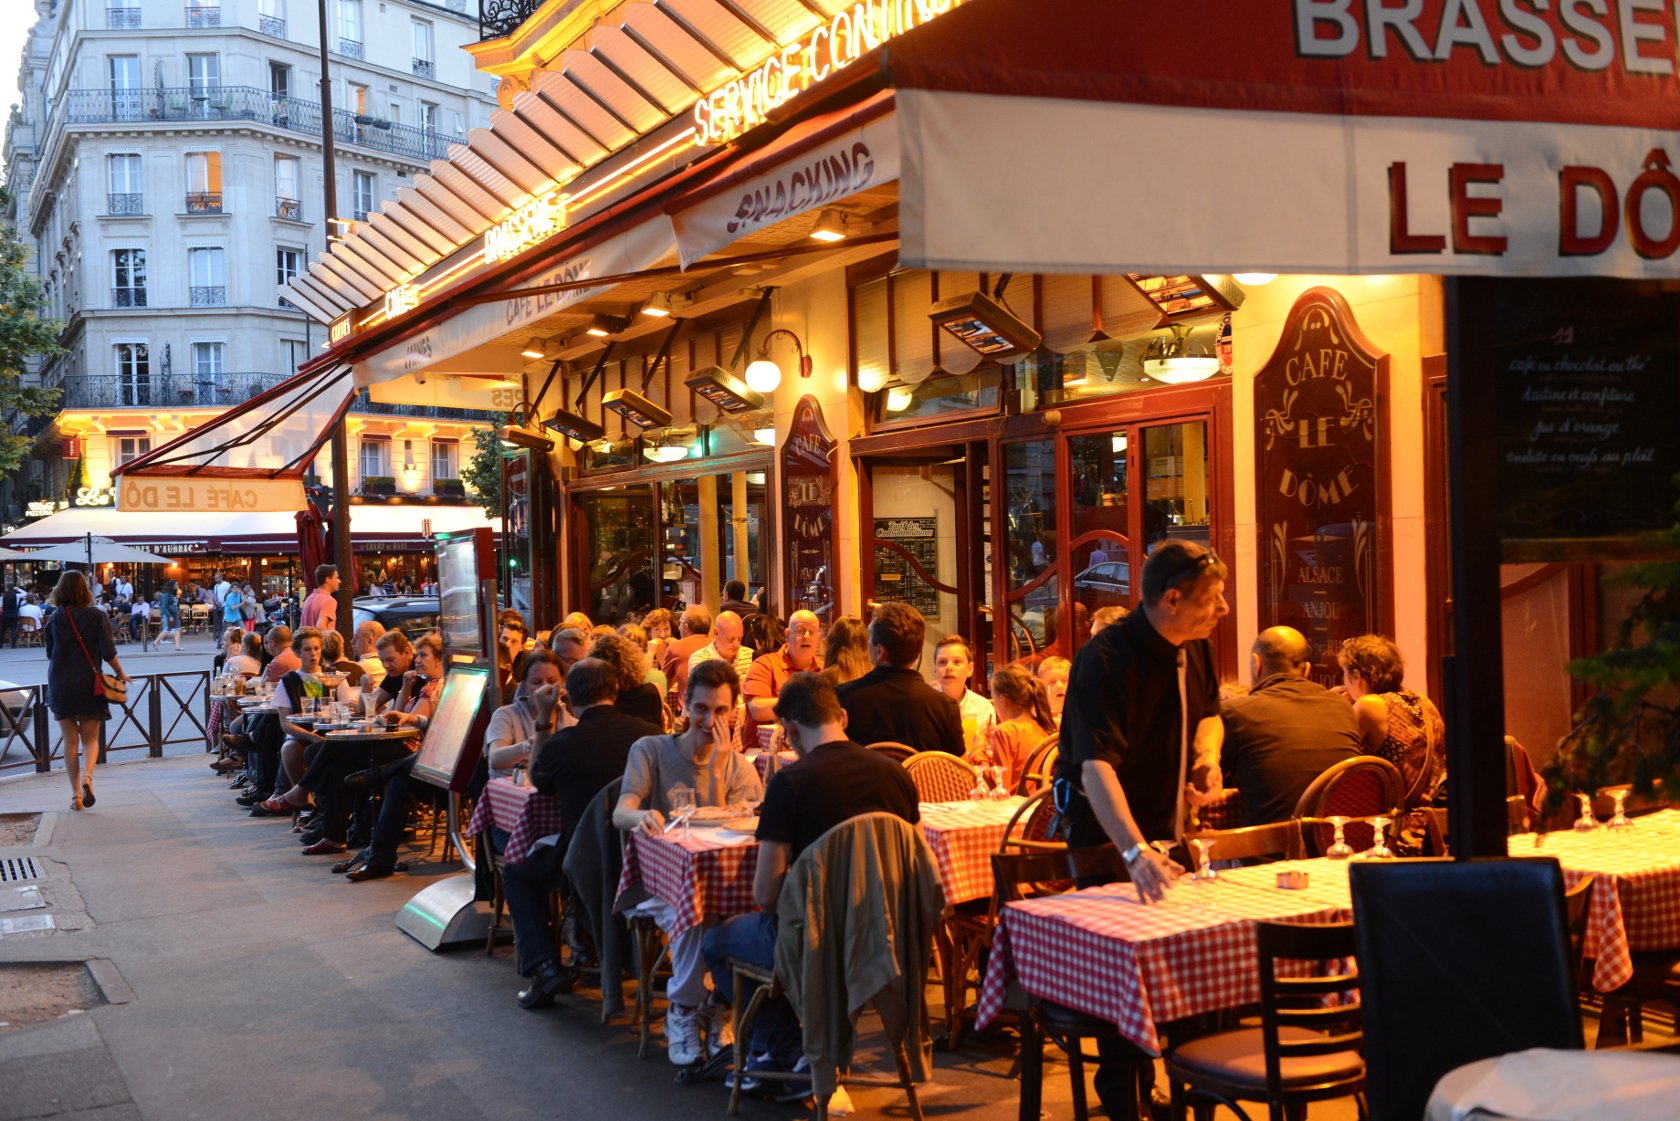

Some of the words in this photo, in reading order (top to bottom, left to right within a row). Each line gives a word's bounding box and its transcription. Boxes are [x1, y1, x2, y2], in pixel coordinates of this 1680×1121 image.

[1295, 0, 1680, 76] BRASSE
[694, 42, 803, 147] SERVICE
[727, 142, 875, 233] SNACKING
[1388, 160, 1508, 257] LE
[1285, 348, 1349, 386] CAFE
[1299, 416, 1337, 448] LE
[801, 481, 817, 502] LE
[153, 544, 194, 554] D'AUBRAC
[1296, 565, 1345, 585] ALSACE
[1303, 601, 1341, 619] ANJOU
